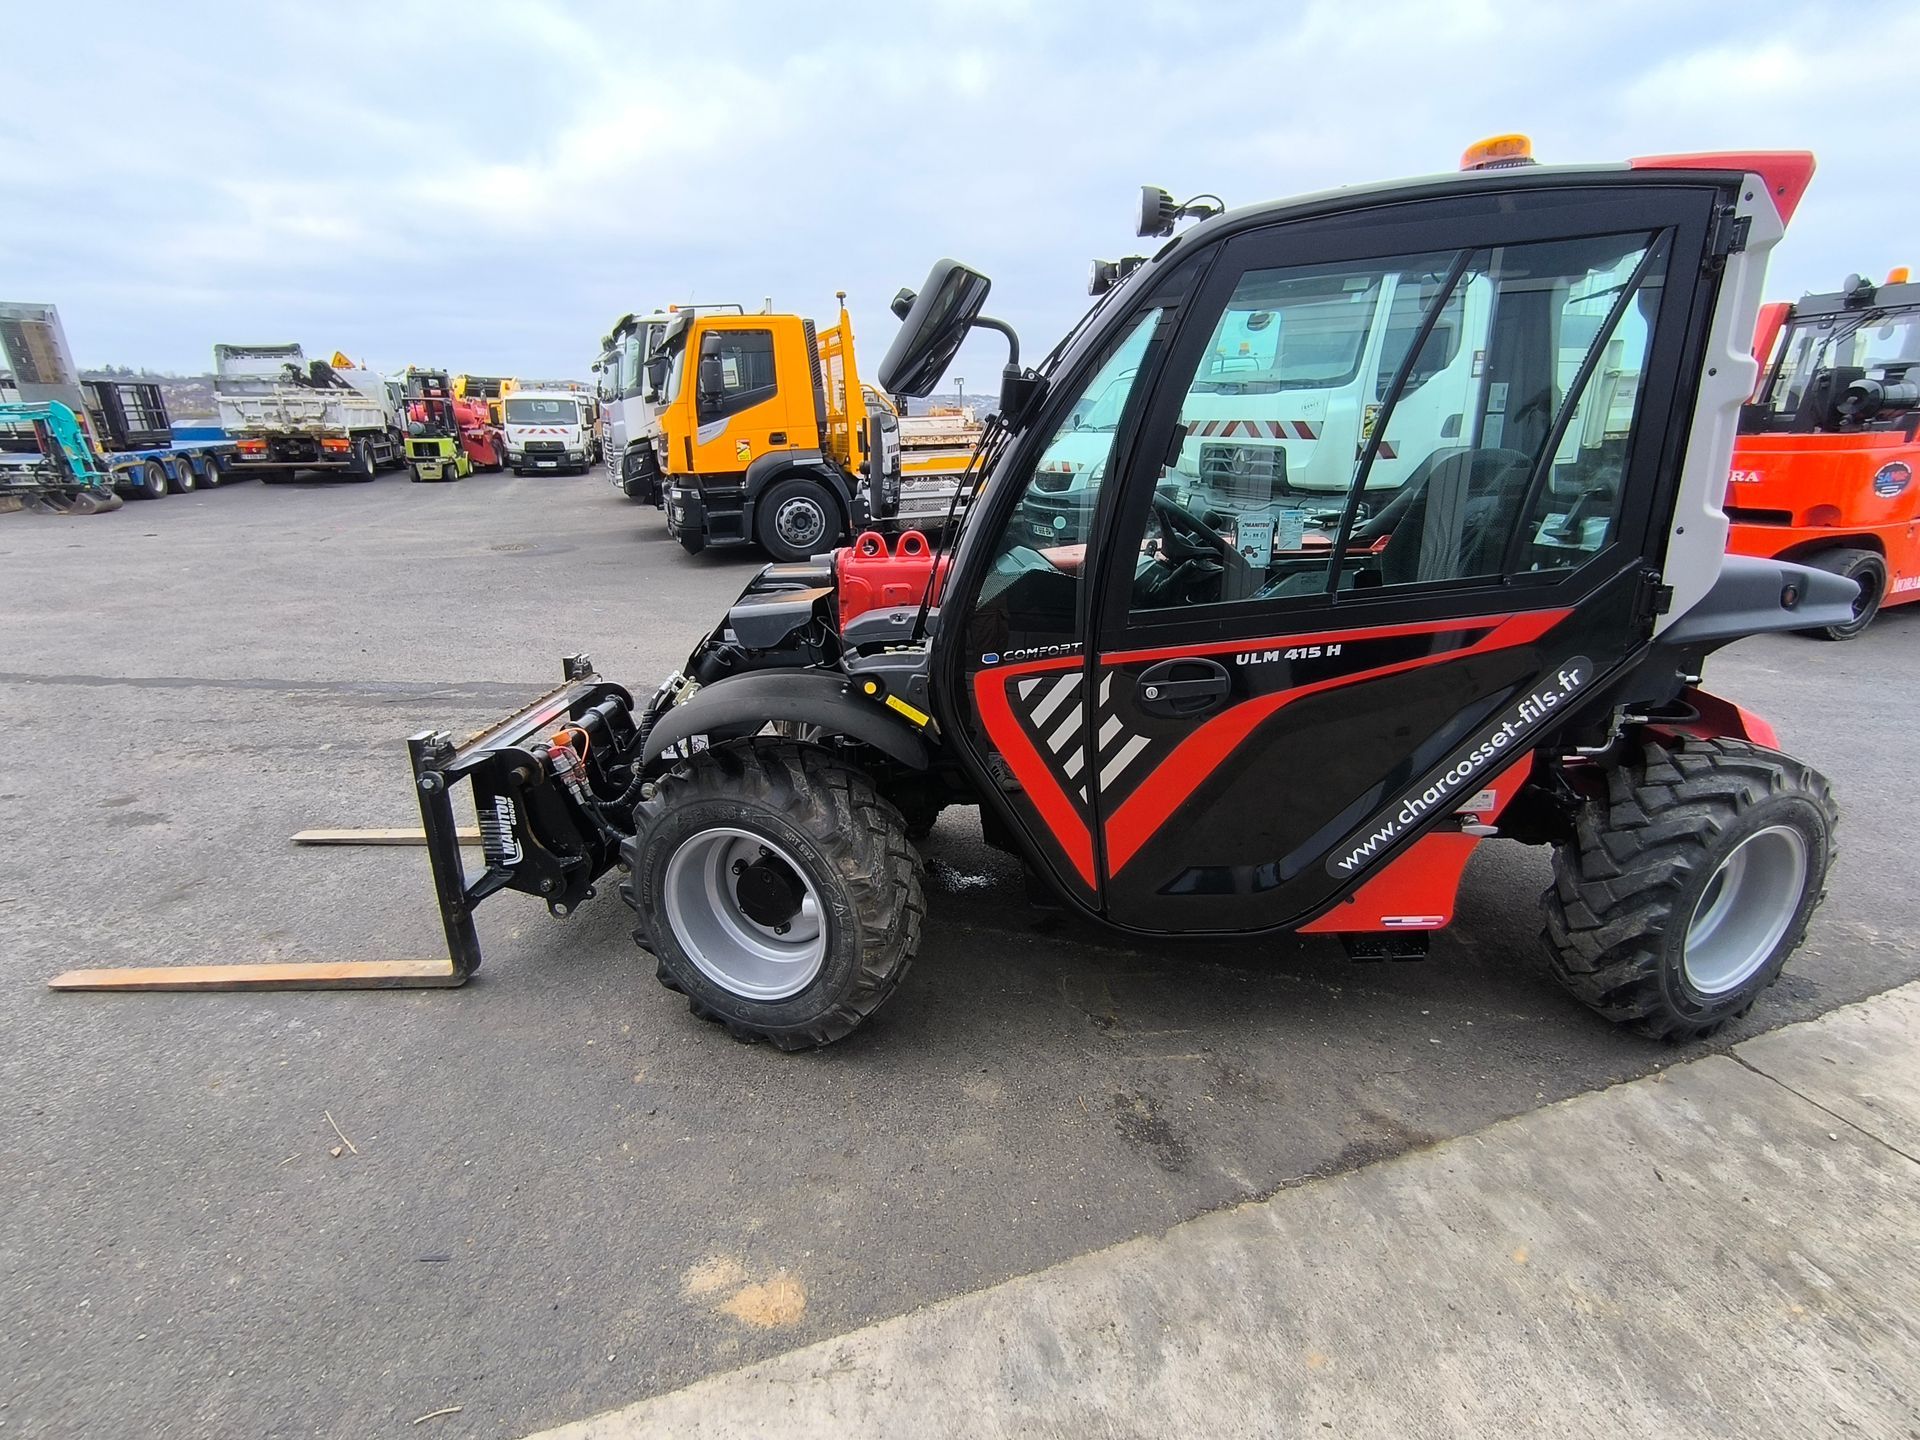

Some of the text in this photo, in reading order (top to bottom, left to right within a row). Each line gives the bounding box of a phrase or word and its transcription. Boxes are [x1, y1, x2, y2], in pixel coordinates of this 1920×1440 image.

[1003, 642, 1083, 661] COMFORT
[1235, 644, 1342, 666] ULM 415 H
[1338, 667, 1582, 870] www.charcosset-fils.fr
[494, 794, 516, 855] MANITOU
[507, 796, 517, 826] GROUP
